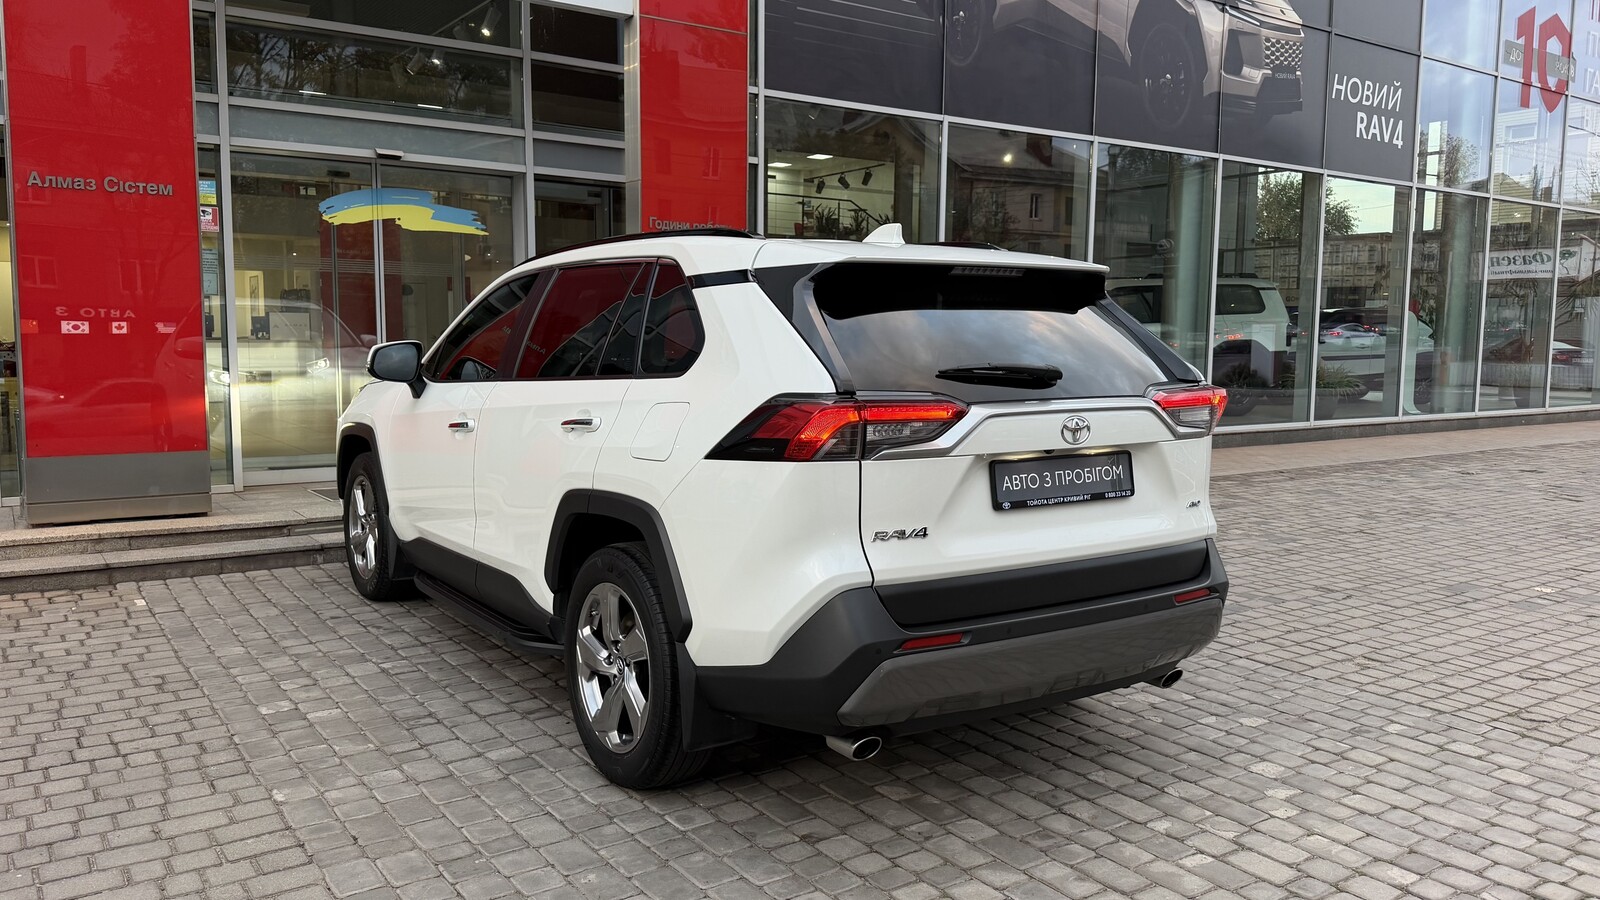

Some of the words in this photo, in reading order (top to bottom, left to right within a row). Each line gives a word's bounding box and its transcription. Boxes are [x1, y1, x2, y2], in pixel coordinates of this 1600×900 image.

[1509, 48, 1522, 62] ДО
[1516, 5, 1571, 113] 10
[1332, 73, 1402, 112] НОВИЙ
[1356, 111, 1403, 149] RAV4
[27, 171, 96, 191] Алмаз
[103, 176, 173, 196] Сістем
[649, 216, 690, 231] Години
[1002, 473, 1040, 491] АВТО
[1043, 472, 1052, 487] З
[1055, 465, 1124, 486] ПРОБІГОМ
[1027, 499, 1047, 507] ТОЙОТА
[1047, 497, 1064, 505] ЦЕНТР
[1064, 495, 1083, 503] КРИВИЙ
[871, 525, 929, 543] RAV4
